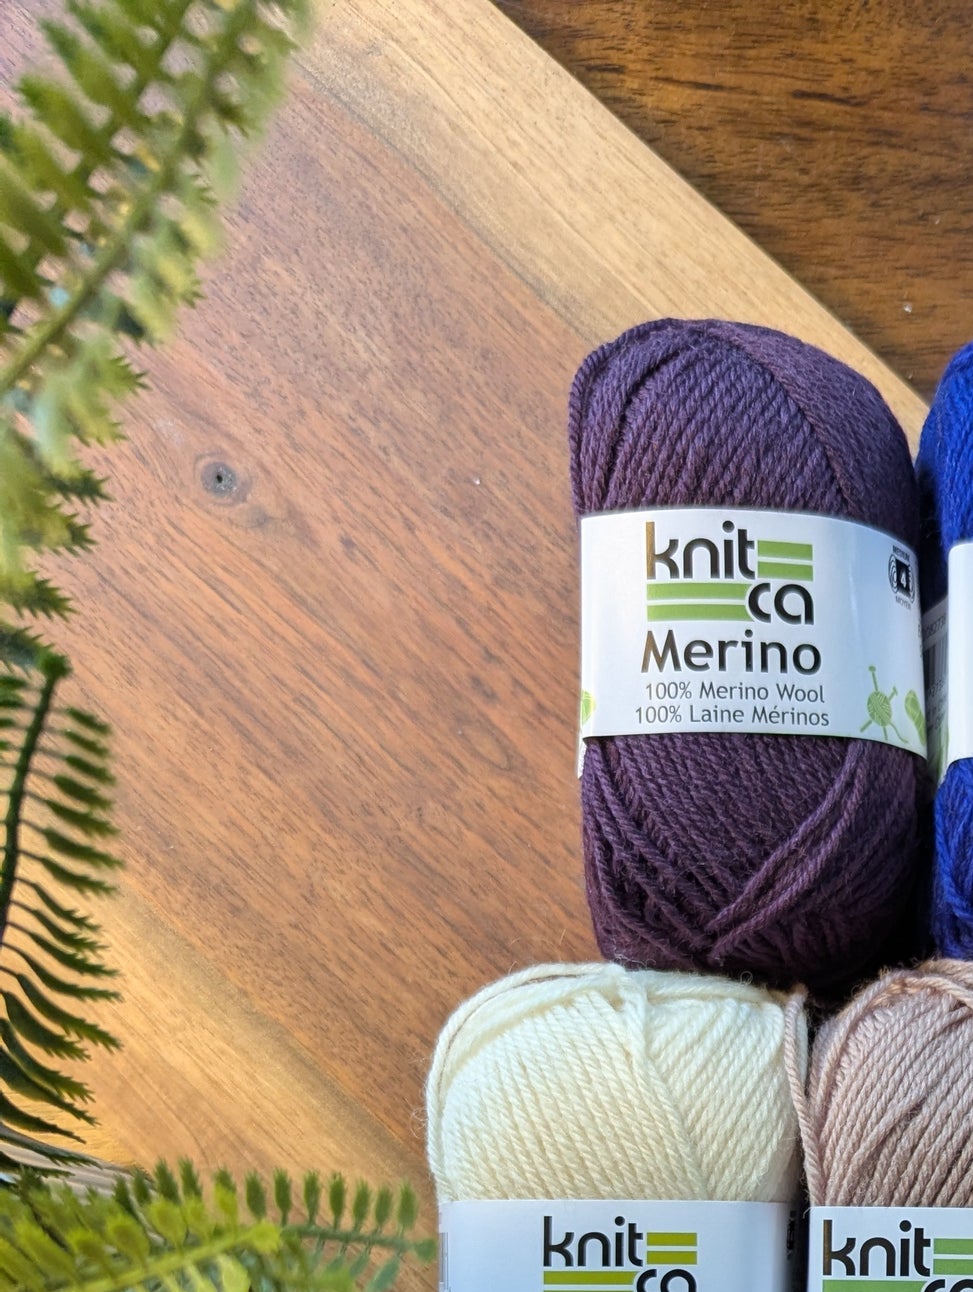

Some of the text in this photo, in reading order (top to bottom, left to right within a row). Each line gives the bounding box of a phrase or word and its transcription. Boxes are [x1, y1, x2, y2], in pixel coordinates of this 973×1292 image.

[646, 520, 755, 580] knit
[900, 571, 907, 588] 4
[748, 582, 815, 625] ca
[641, 629, 822, 675] Merino
[645, 681, 825, 703] 100% Merino Wool
[635, 705, 829, 726] 100% Laine Mérinos
[543, 1216, 643, 1267] knit
[823, 1219, 931, 1277] knit
